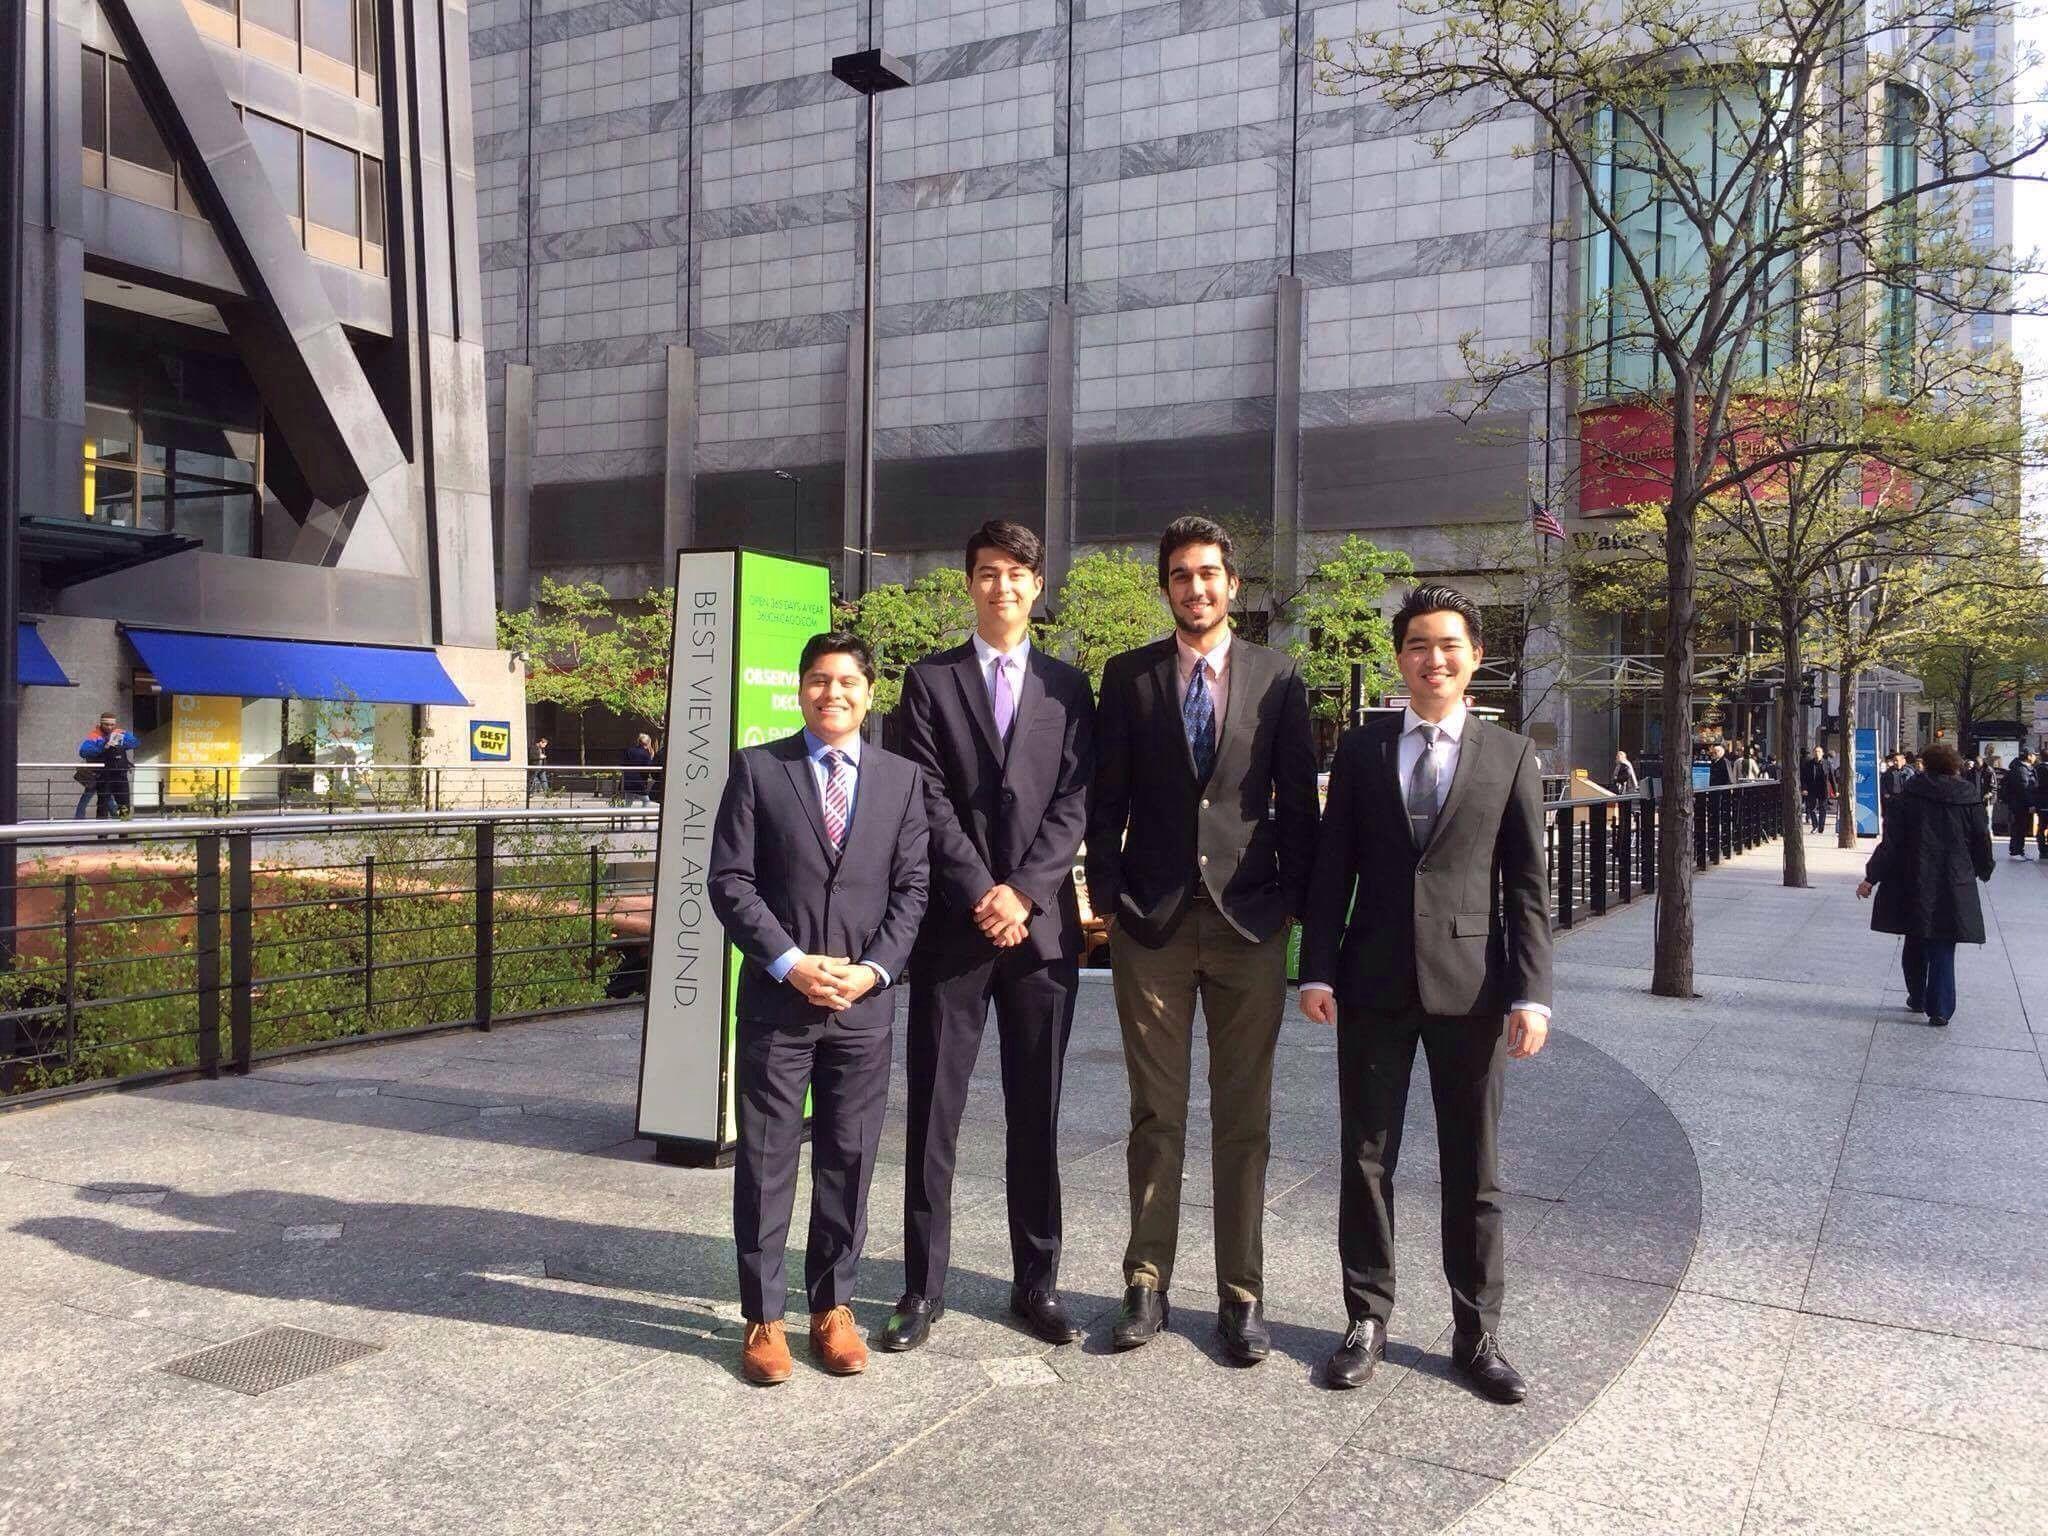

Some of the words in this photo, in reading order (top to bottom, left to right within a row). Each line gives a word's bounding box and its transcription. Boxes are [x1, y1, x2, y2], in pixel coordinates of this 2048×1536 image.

[691, 591, 717, 664] BEST
[480, 731, 507, 741] BEST
[481, 740, 504, 751] BUY
[685, 676, 713, 786] VIEWS.
[682, 799, 706, 846] ALL
[673, 856, 703, 1009] AROUND.
